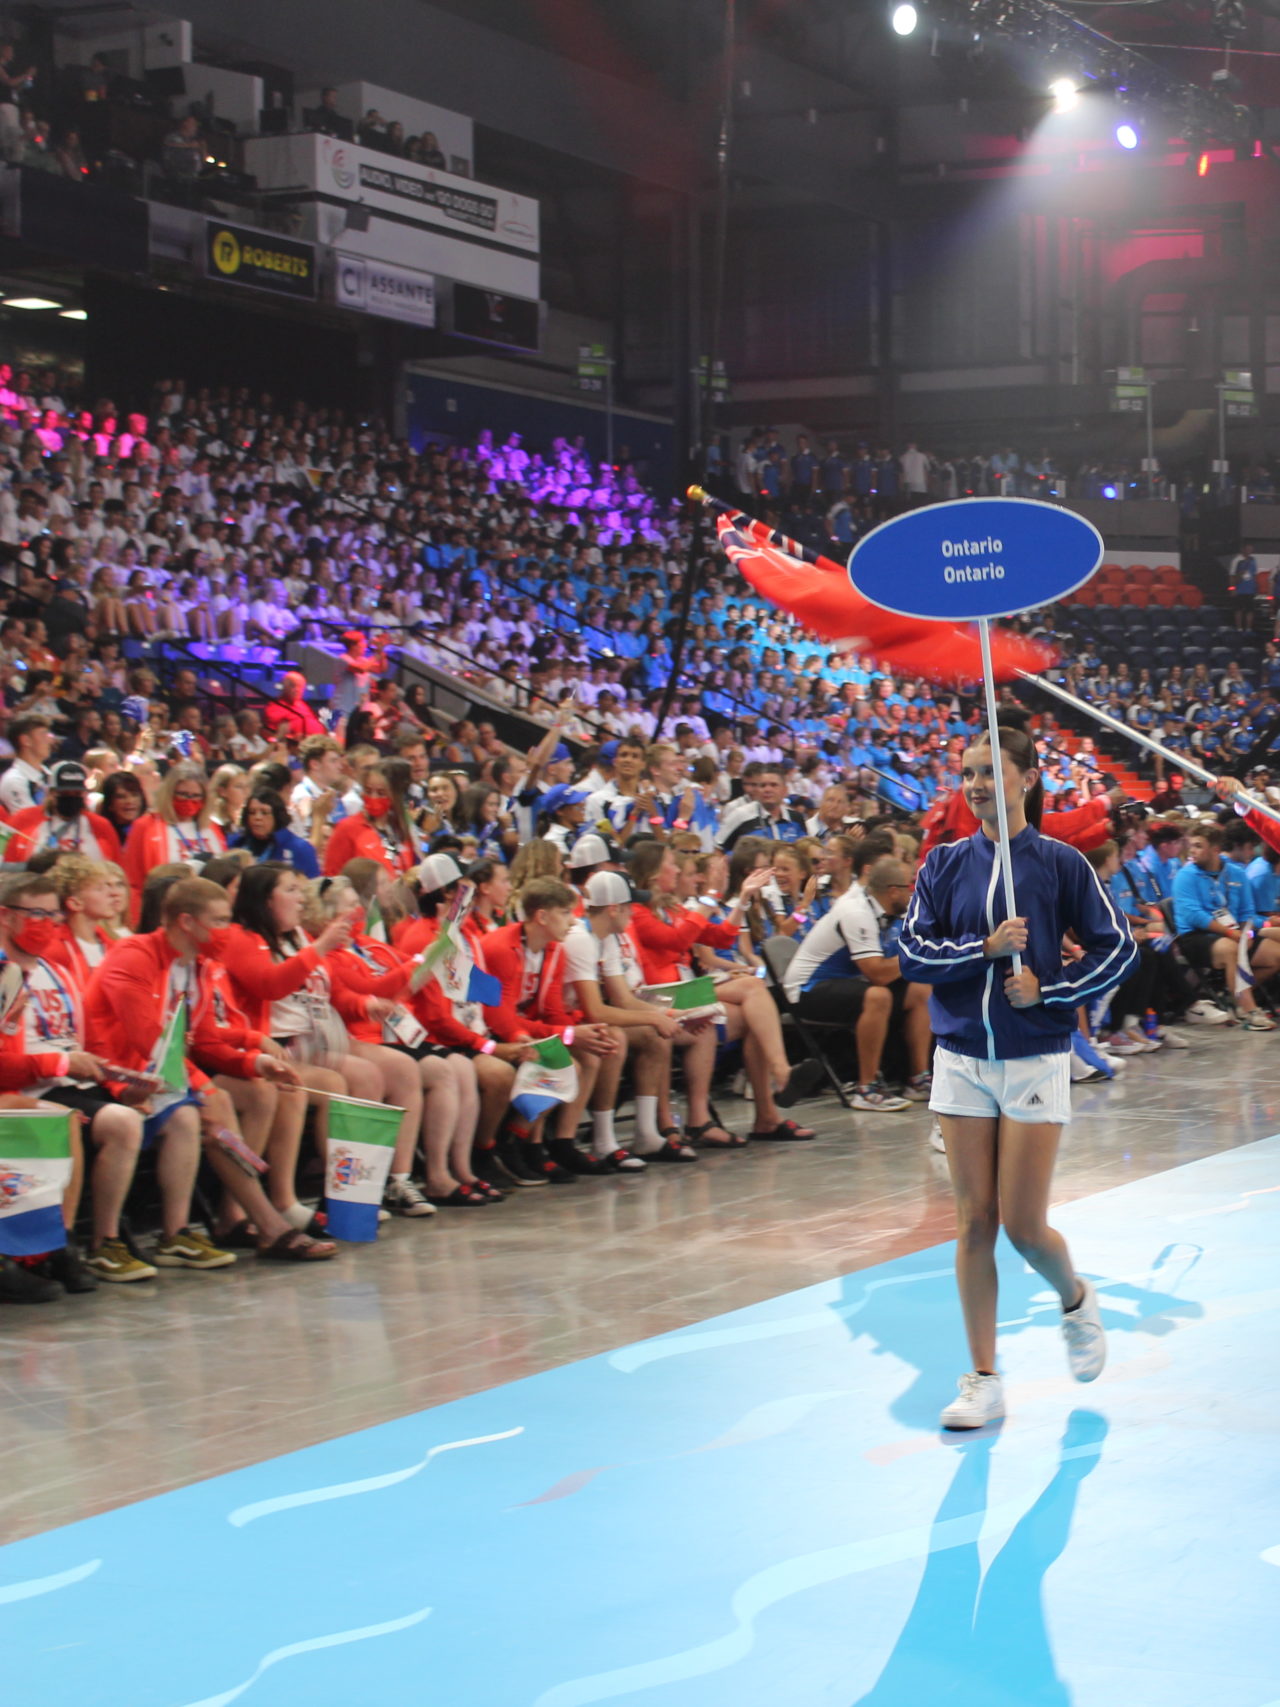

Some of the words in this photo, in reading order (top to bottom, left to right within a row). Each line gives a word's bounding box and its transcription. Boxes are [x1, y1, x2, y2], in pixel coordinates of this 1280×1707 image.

[242, 245, 309, 278] ROBERTS
[370, 274, 433, 304] ASSANTE
[941, 535, 1003, 558] Ontario
[943, 562, 1005, 584] Ontario
